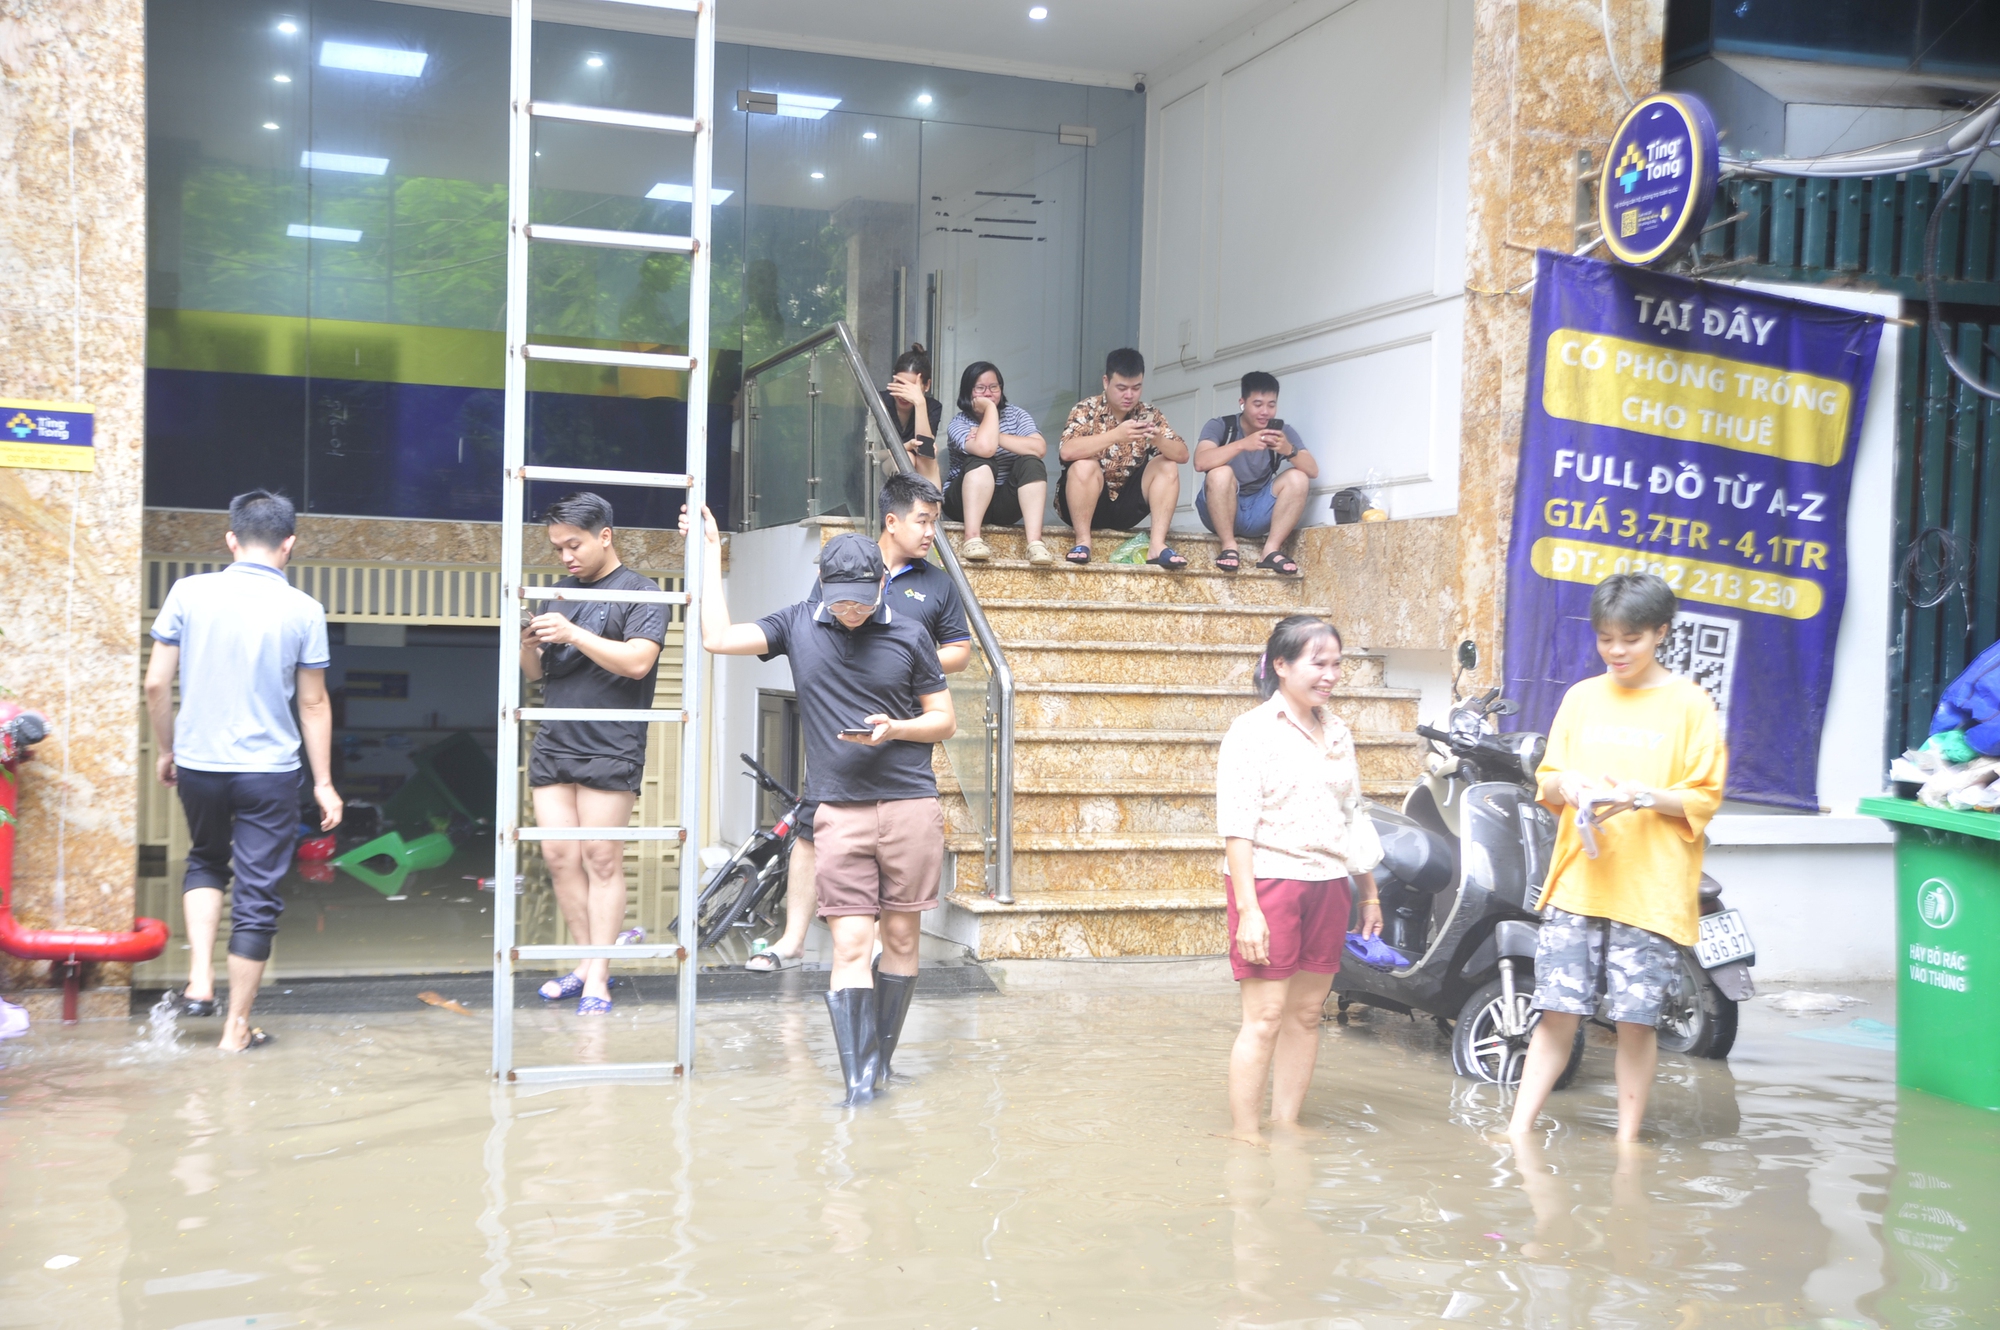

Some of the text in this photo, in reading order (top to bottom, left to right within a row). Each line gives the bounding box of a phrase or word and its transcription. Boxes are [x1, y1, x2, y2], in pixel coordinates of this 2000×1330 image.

[1646, 139, 1679, 162] Ting
[1645, 158, 1680, 182] Tong
[1635, 295, 1775, 346] TẠI ĐÂY
[1560, 339, 1839, 416] CÓ PHÒNG TRỐNG
[36, 416, 67, 430] Ting
[36, 427, 70, 440] Tong
[1622, 396, 1774, 447] CHO THUÊ
[1554, 449, 1827, 522] FULL ĐỒ TỪ A-Z
[1544, 496, 1610, 534] GIÁ
[1618, 509, 1710, 552] 3,7TR
[1735, 528, 1828, 571] 4,1TR
[1552, 545, 1607, 579] ĐT:
[1690, 568, 1742, 600] 213
[1752, 579, 1797, 611] 230
[1701, 933, 1747, 963] 486.97
[1927, 945, 1940, 966] BỎ
[1942, 951, 1965, 971] RÁC
[1909, 963, 1966, 993] VÀO THÙNG
